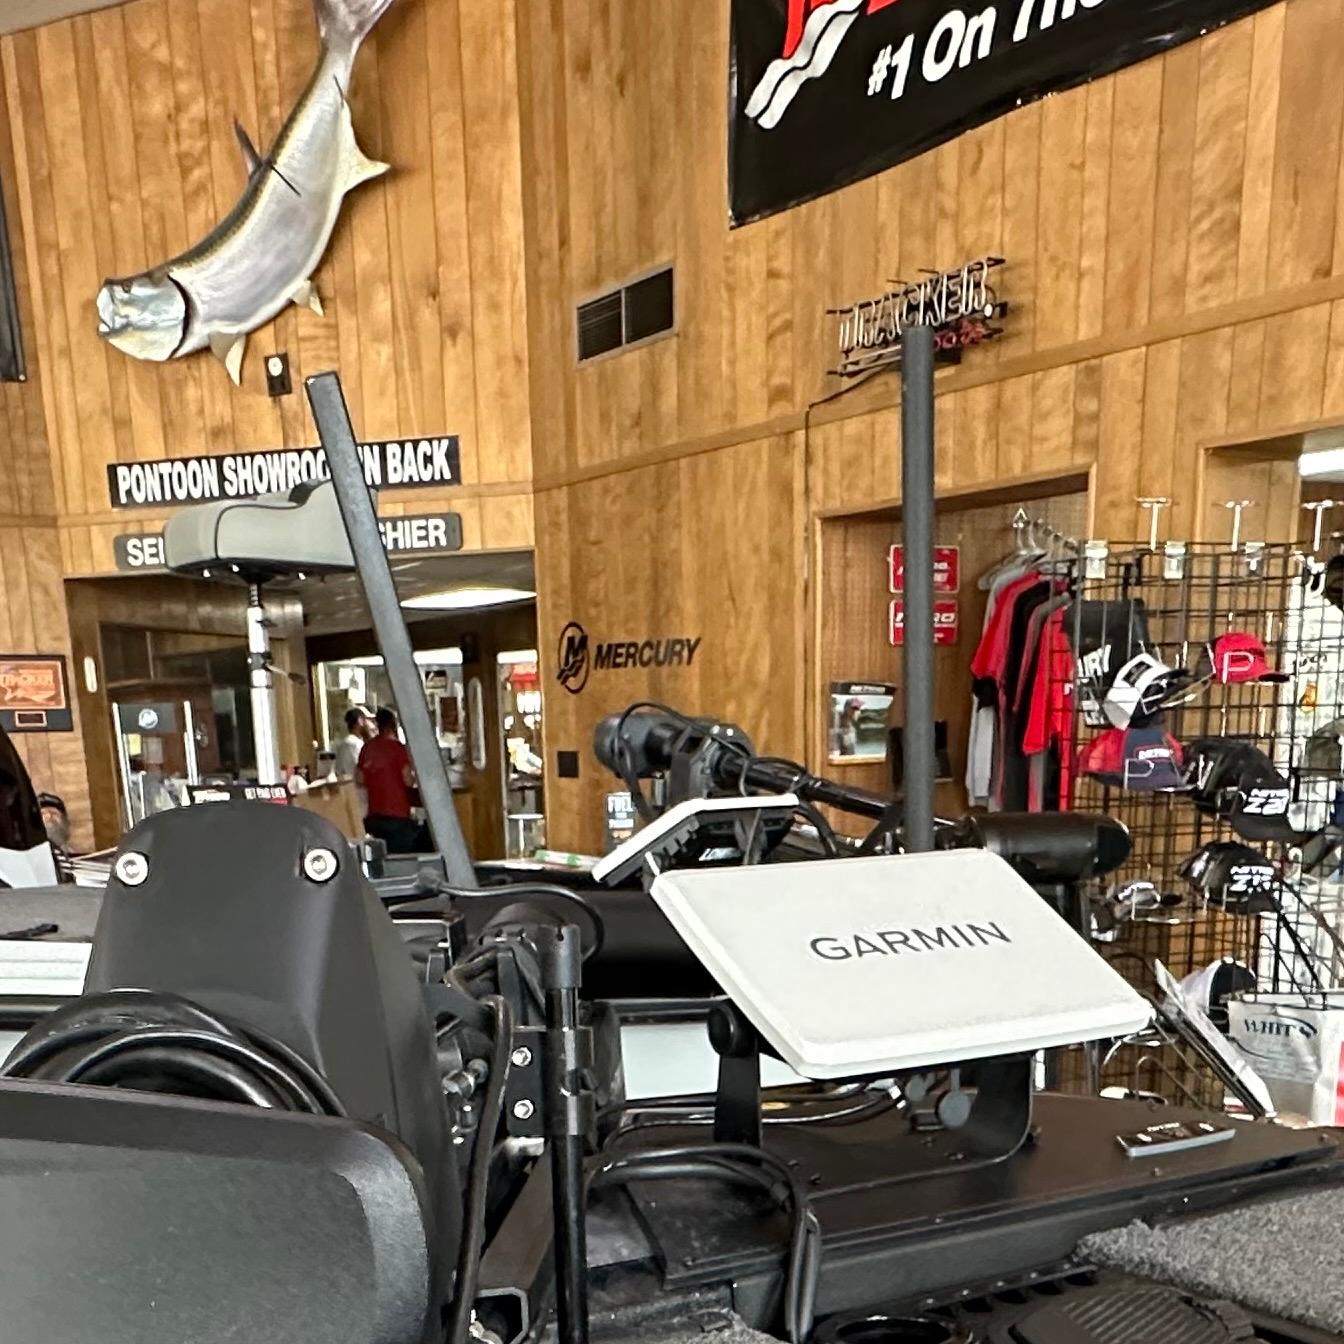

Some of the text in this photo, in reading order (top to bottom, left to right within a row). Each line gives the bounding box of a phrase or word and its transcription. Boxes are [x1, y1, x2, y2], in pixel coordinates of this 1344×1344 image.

[867, 33, 915, 100] #1
[922, 6, 997, 82] On
[116, 458, 220, 504] PONTOON
[223, 449, 332, 497] SHOWROO
[385, 439, 452, 483] BACK
[594, 637, 702, 670] MERCURY
[810, 921, 1012, 962] GARMIN
